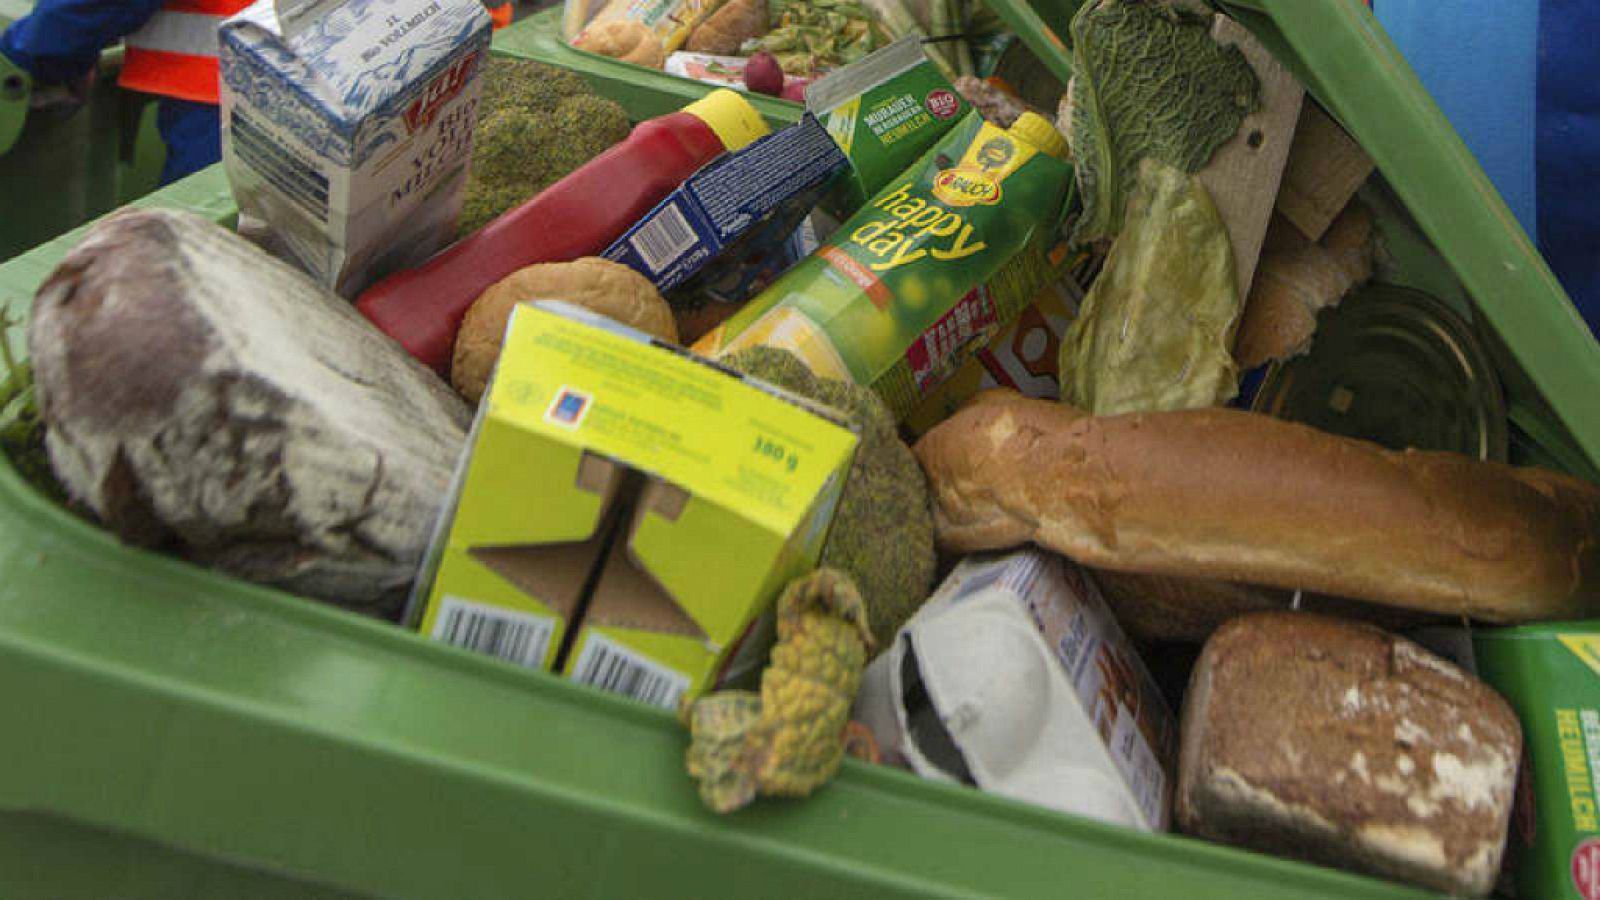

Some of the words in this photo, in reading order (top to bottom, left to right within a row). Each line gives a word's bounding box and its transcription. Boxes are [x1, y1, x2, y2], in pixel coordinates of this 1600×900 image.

[928, 93, 954, 111] BIO
[851, 218, 928, 271] day
[874, 182, 988, 260] happy
[1556, 708, 1597, 831] HEUMILCH
